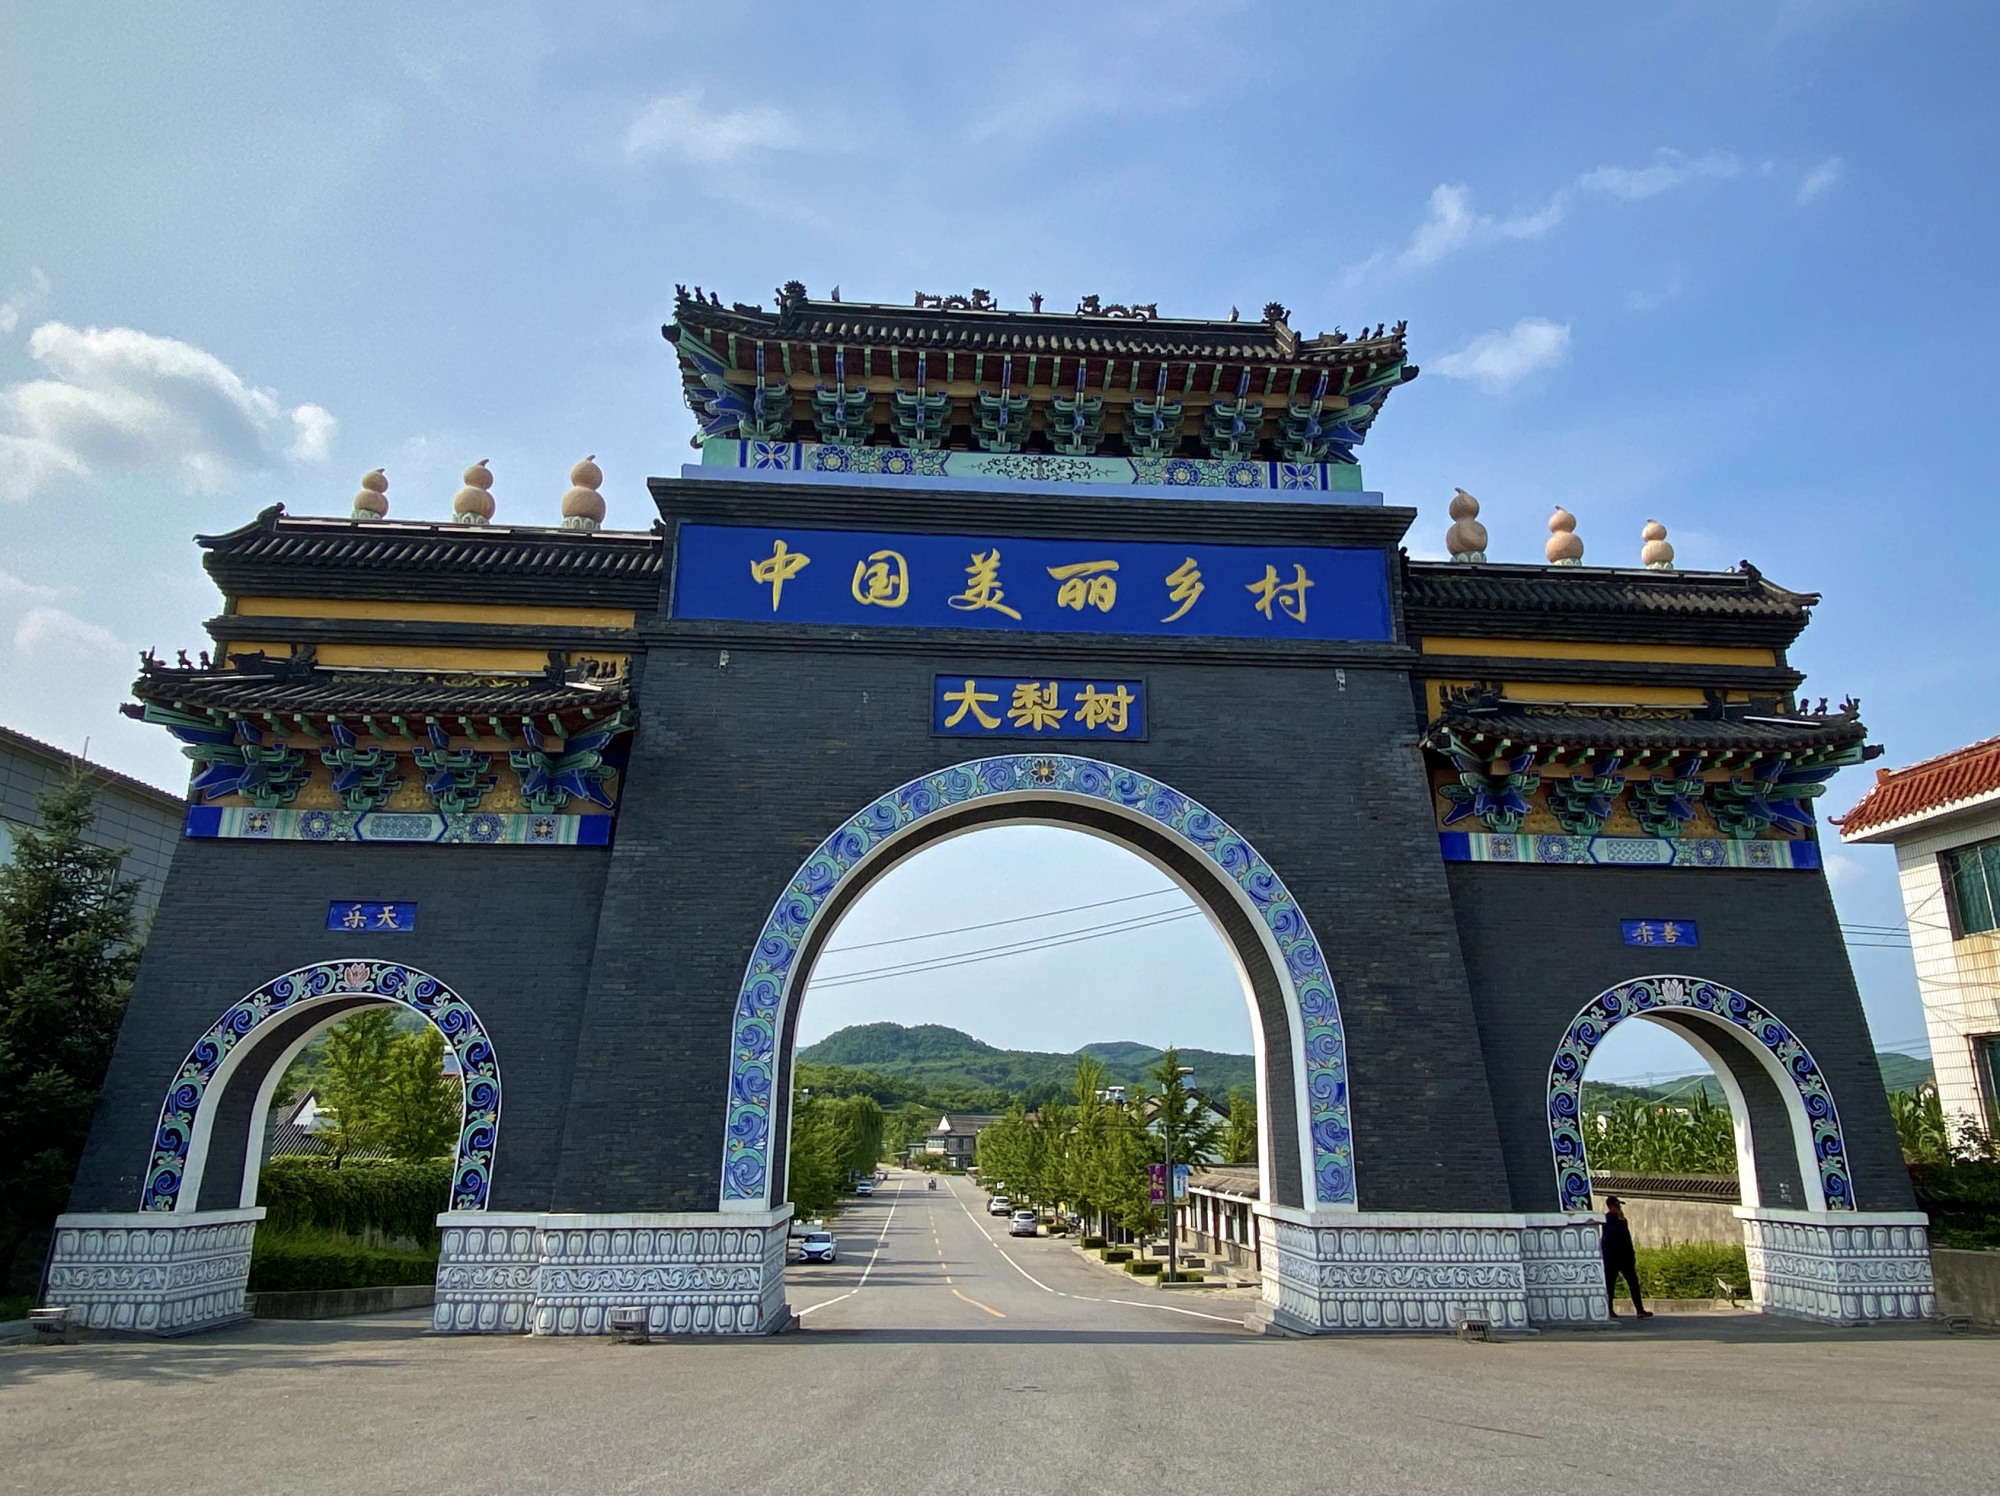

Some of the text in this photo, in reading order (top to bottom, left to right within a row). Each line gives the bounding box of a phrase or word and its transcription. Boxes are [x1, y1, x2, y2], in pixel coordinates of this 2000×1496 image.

[750, 539, 1315, 623] 中国美丽乡村
[943, 679, 1135, 732] 大梨树
